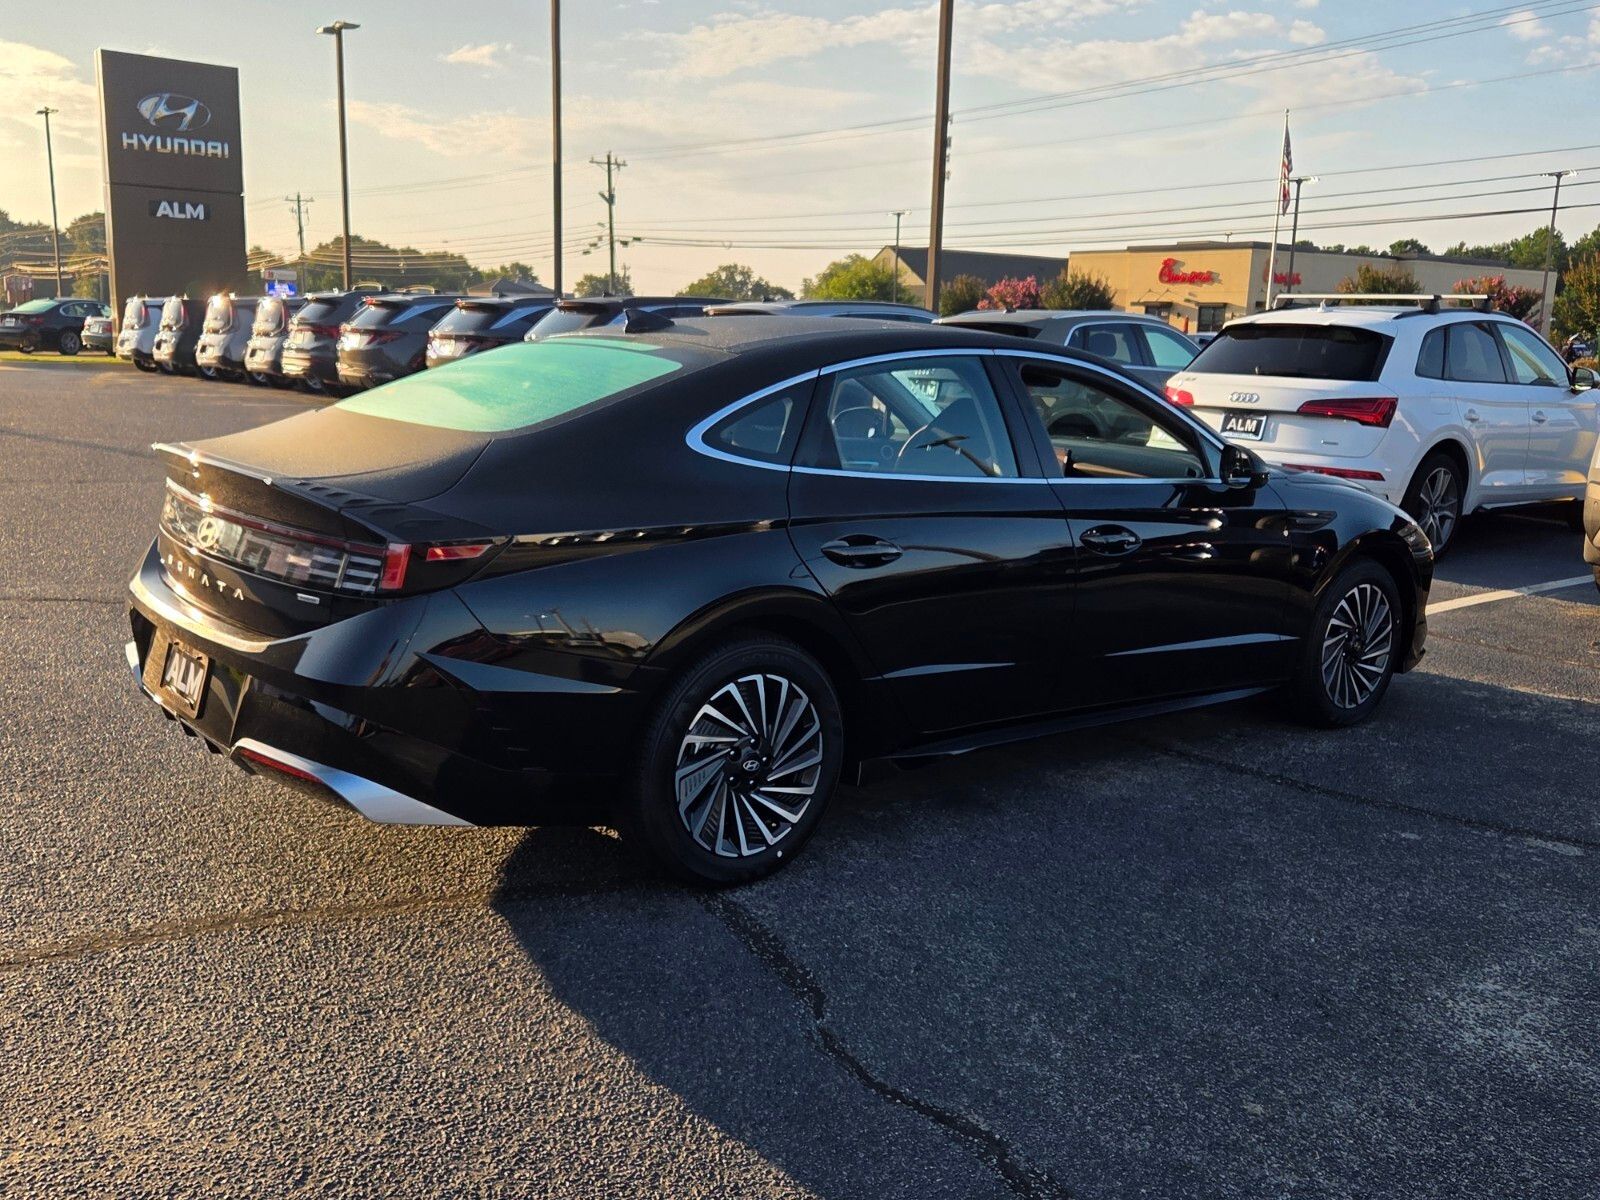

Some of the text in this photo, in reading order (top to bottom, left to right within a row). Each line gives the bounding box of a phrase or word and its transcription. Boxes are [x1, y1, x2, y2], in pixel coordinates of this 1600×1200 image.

[121, 131, 229, 159] HYUNDAI
[156, 200, 205, 221] ALM
[1226, 417, 1258, 432] ALM
[165, 652, 204, 702] ALM
